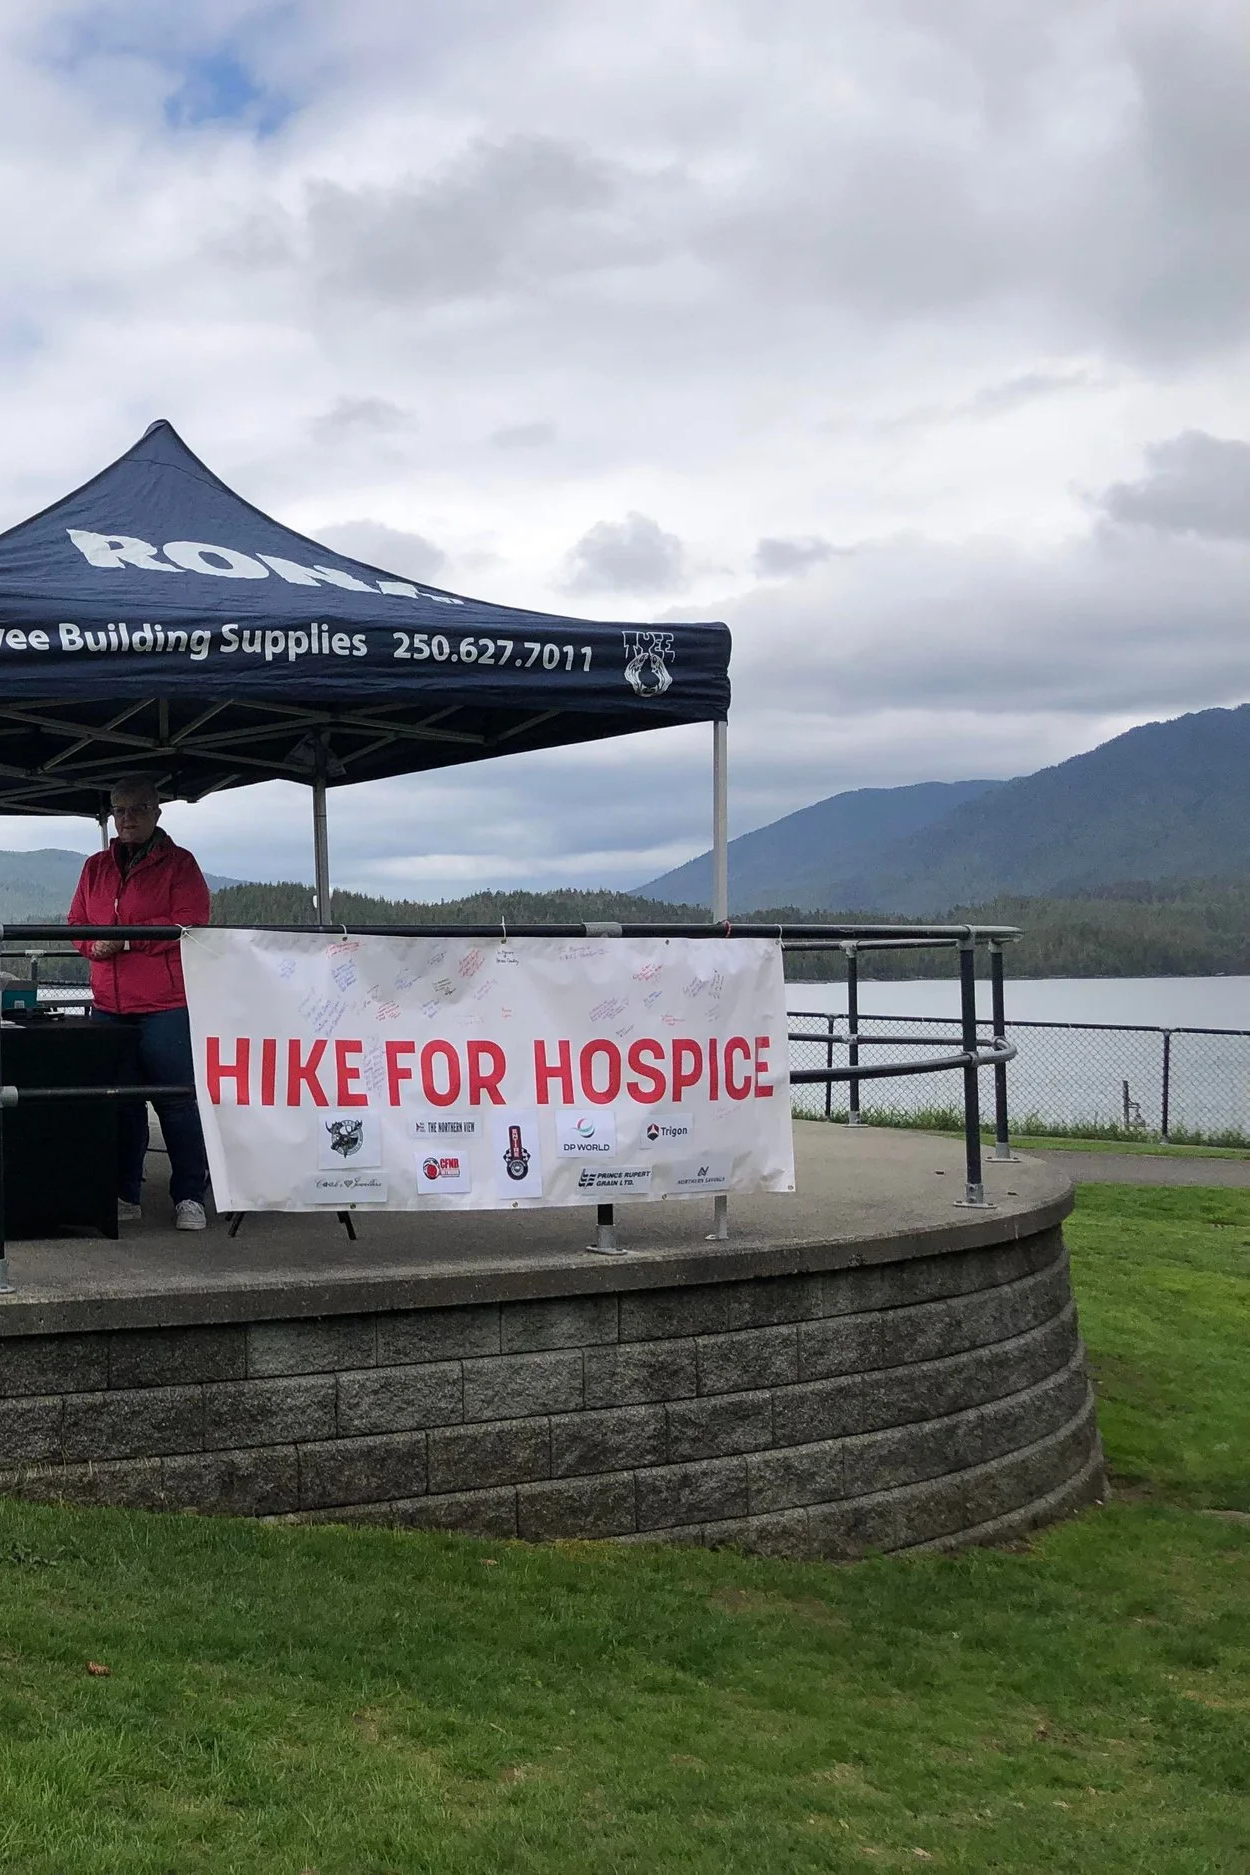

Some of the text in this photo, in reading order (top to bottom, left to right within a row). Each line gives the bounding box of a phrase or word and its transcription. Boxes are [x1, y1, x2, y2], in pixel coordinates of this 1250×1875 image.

[58, 623, 211, 660] Building
[220, 623, 368, 661] Supplies
[392, 632, 592, 671] 250.627.7011
[206, 1036, 368, 1107] HIKE
[385, 1039, 507, 1107] FOR
[533, 1036, 773, 1105] HOSPICE
[428, 1122, 437, 1133] THE
[661, 1126, 688, 1138] Trigon
[564, 1143, 610, 1151] DP WORLD
[624, 1170, 651, 1178] RUPERT
